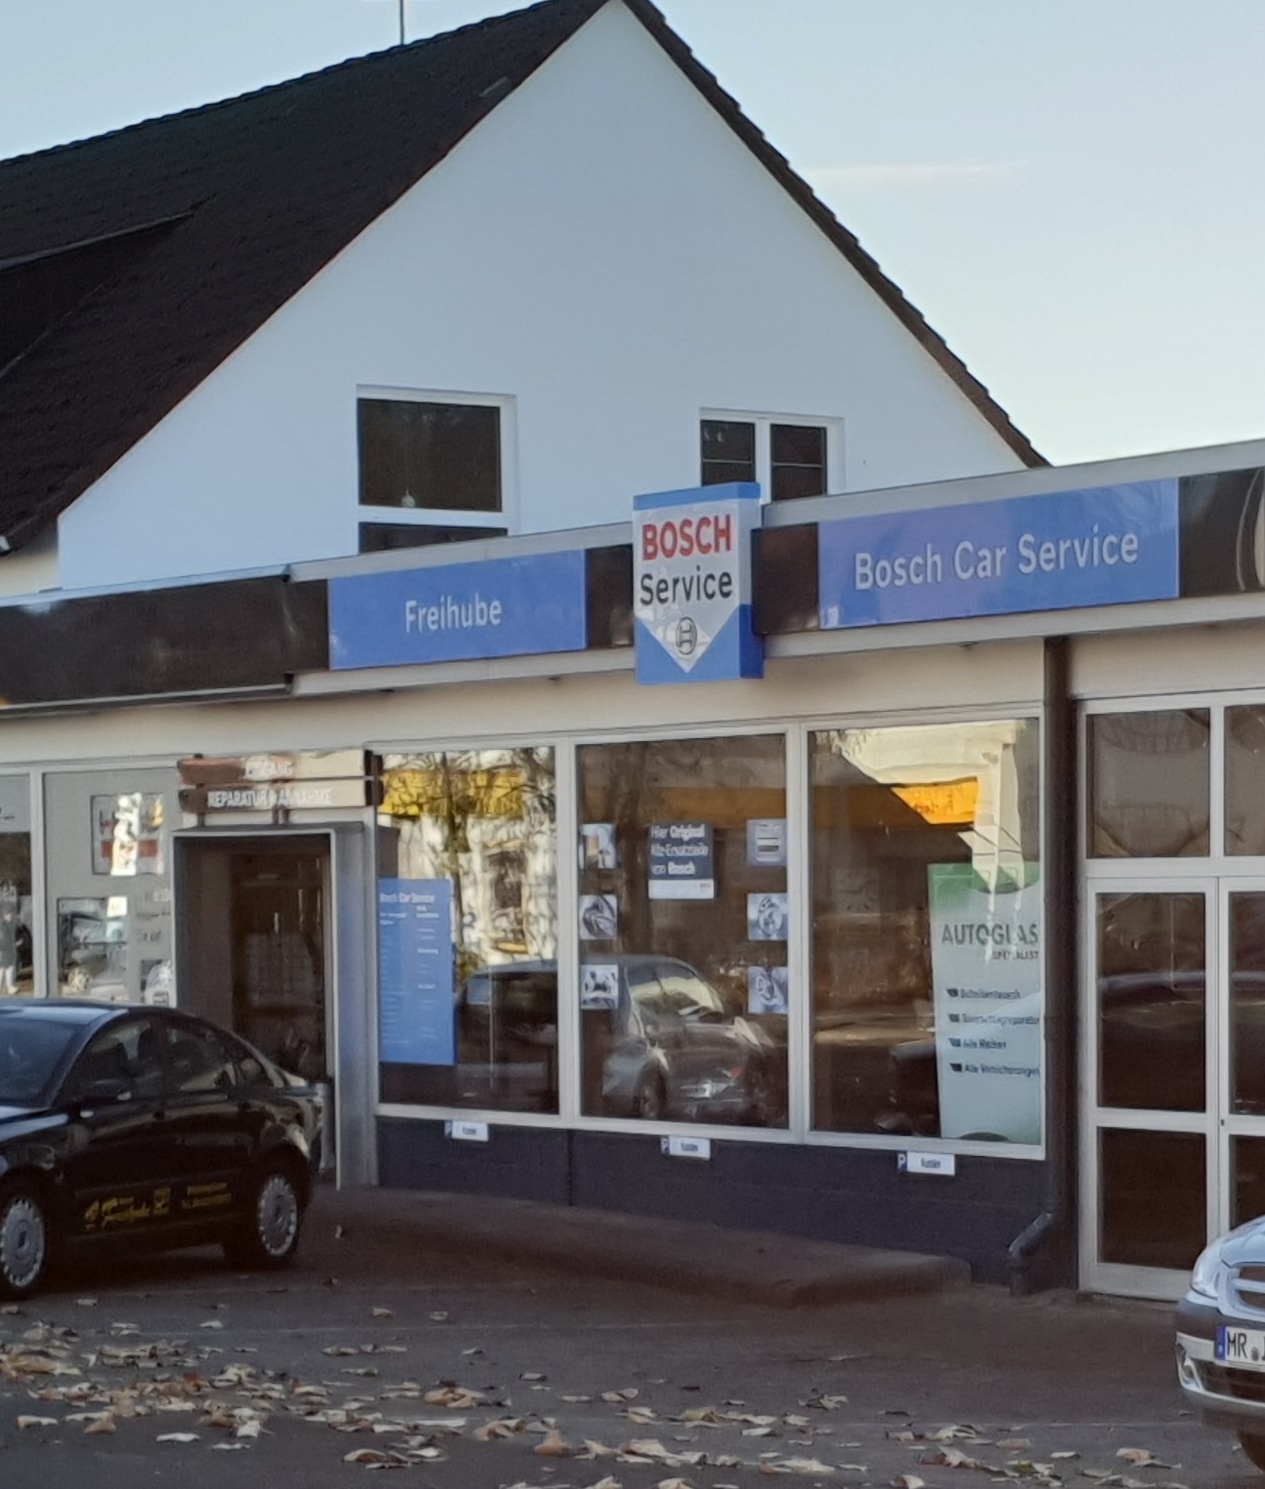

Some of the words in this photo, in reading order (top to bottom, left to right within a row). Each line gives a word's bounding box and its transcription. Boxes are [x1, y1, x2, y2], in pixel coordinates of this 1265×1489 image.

[642, 514, 731, 561] BOSCH
[854, 544, 942, 590] Bosch
[954, 541, 1007, 579] Car
[1019, 524, 1139, 574] Service
[640, 565, 733, 606] Service
[405, 593, 502, 633] Freihube
[942, 923, 1039, 946] AUTOGLAS
[1227, 1330, 1248, 1359] MR
